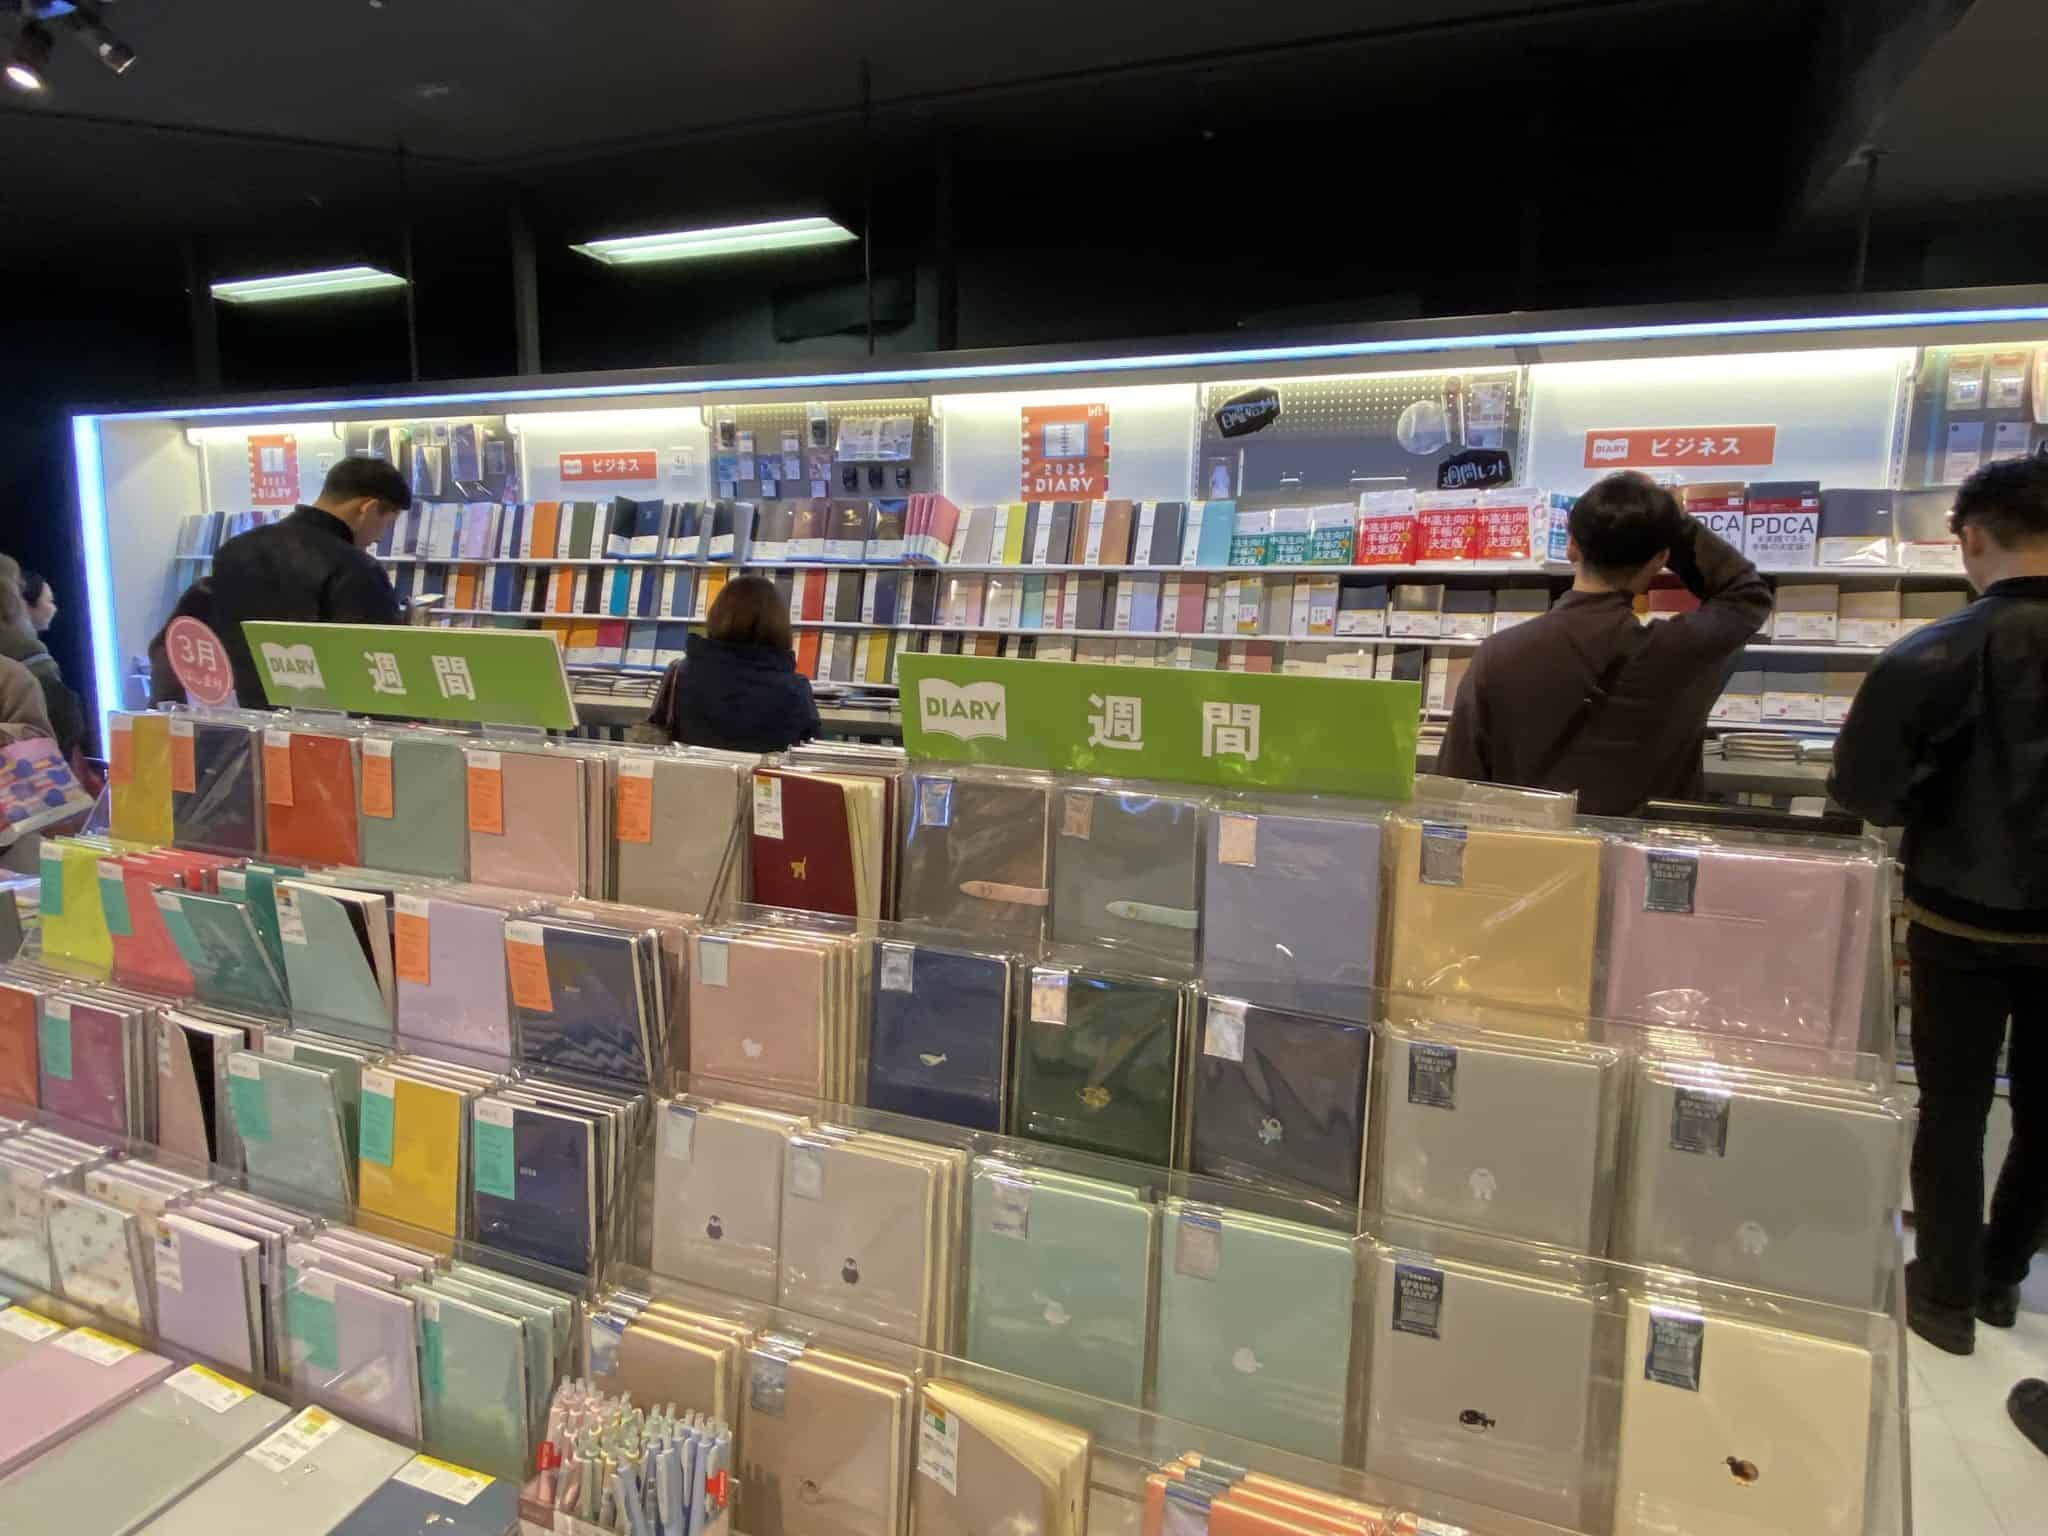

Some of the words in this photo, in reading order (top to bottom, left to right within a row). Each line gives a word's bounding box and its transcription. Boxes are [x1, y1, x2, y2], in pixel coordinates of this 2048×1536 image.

[1650, 437, 1740, 457] ビジネス
[593, 459, 640, 473] ビジネス
[1036, 477, 1093, 492] DIARY
[1751, 517, 1815, 534] PDCA
[176, 634, 217, 672] 3月
[269, 656, 315, 676] DIARY
[363, 650, 476, 701] 週間
[926, 696, 1001, 722] DIARY
[1087, 692, 1261, 762] 週間
